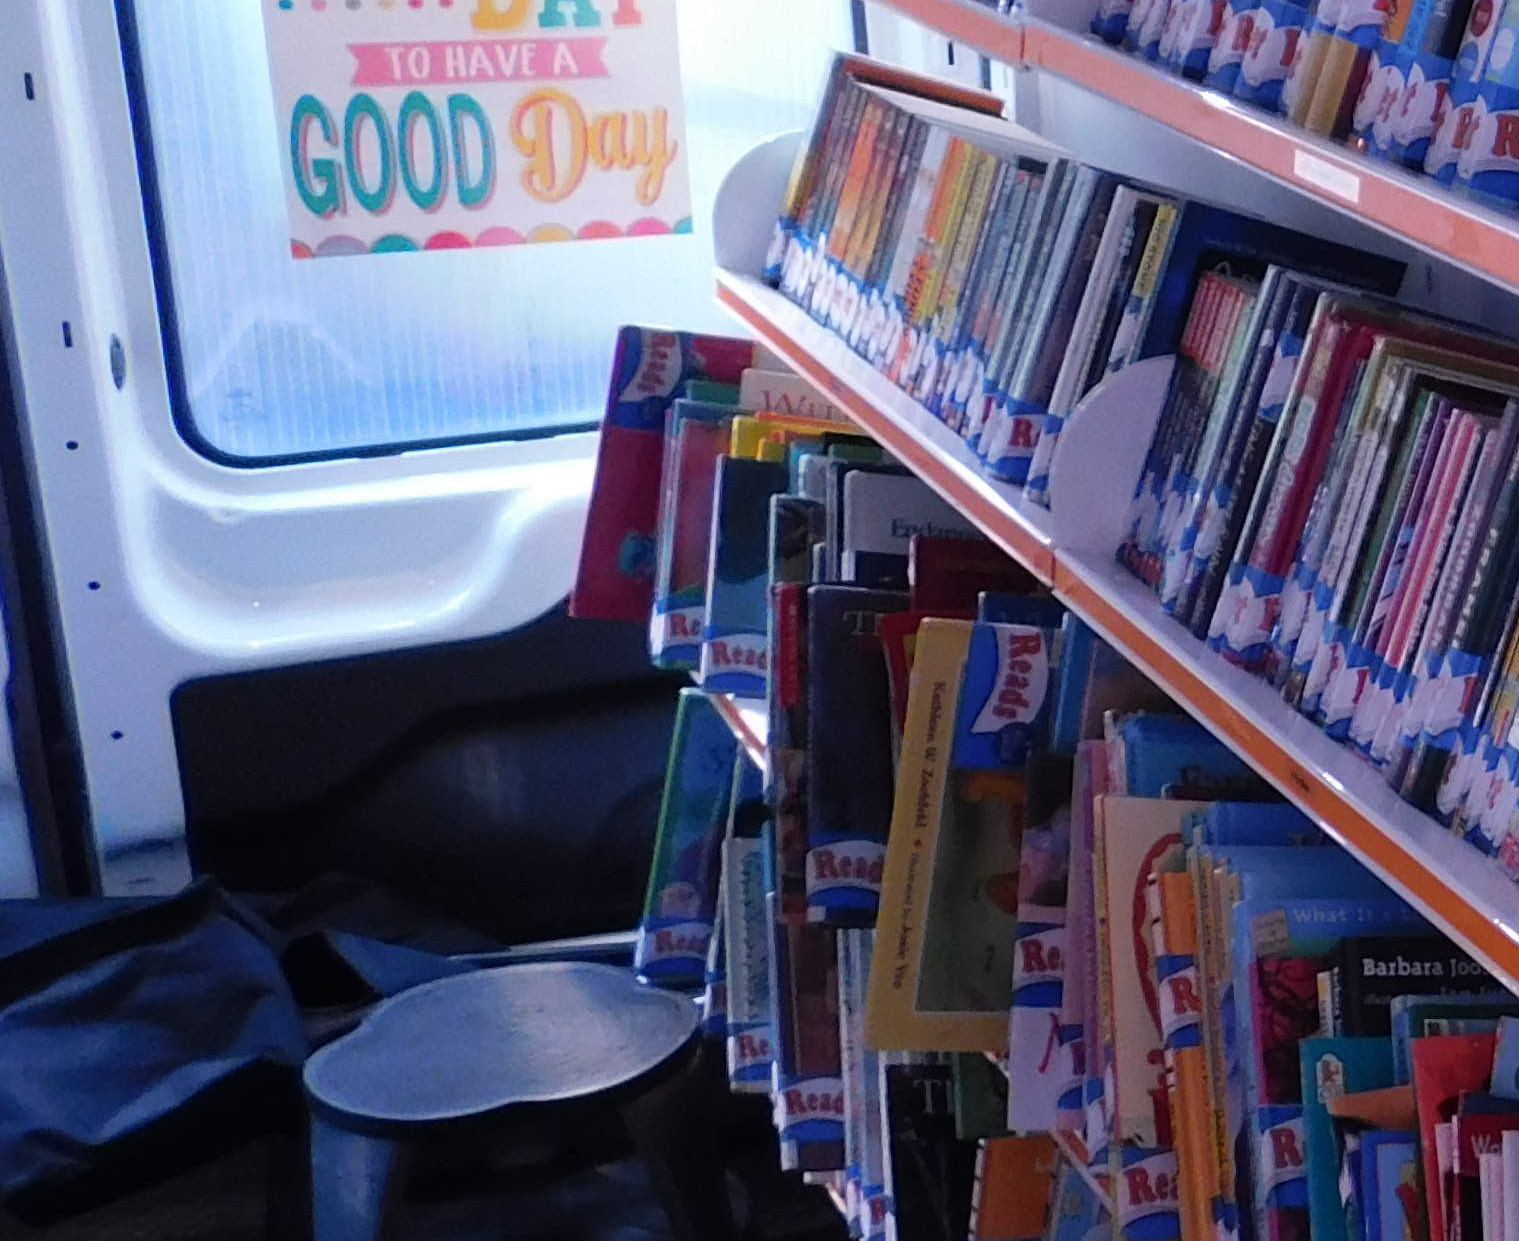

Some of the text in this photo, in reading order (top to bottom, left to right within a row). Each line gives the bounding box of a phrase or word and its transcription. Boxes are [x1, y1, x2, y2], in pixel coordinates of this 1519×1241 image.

[384, 41, 580, 80] TO HAVE A
[289, 87, 678, 218] GOOD Day
[989, 631, 1045, 729] Reads
[1361, 957, 1444, 978] Barbara
